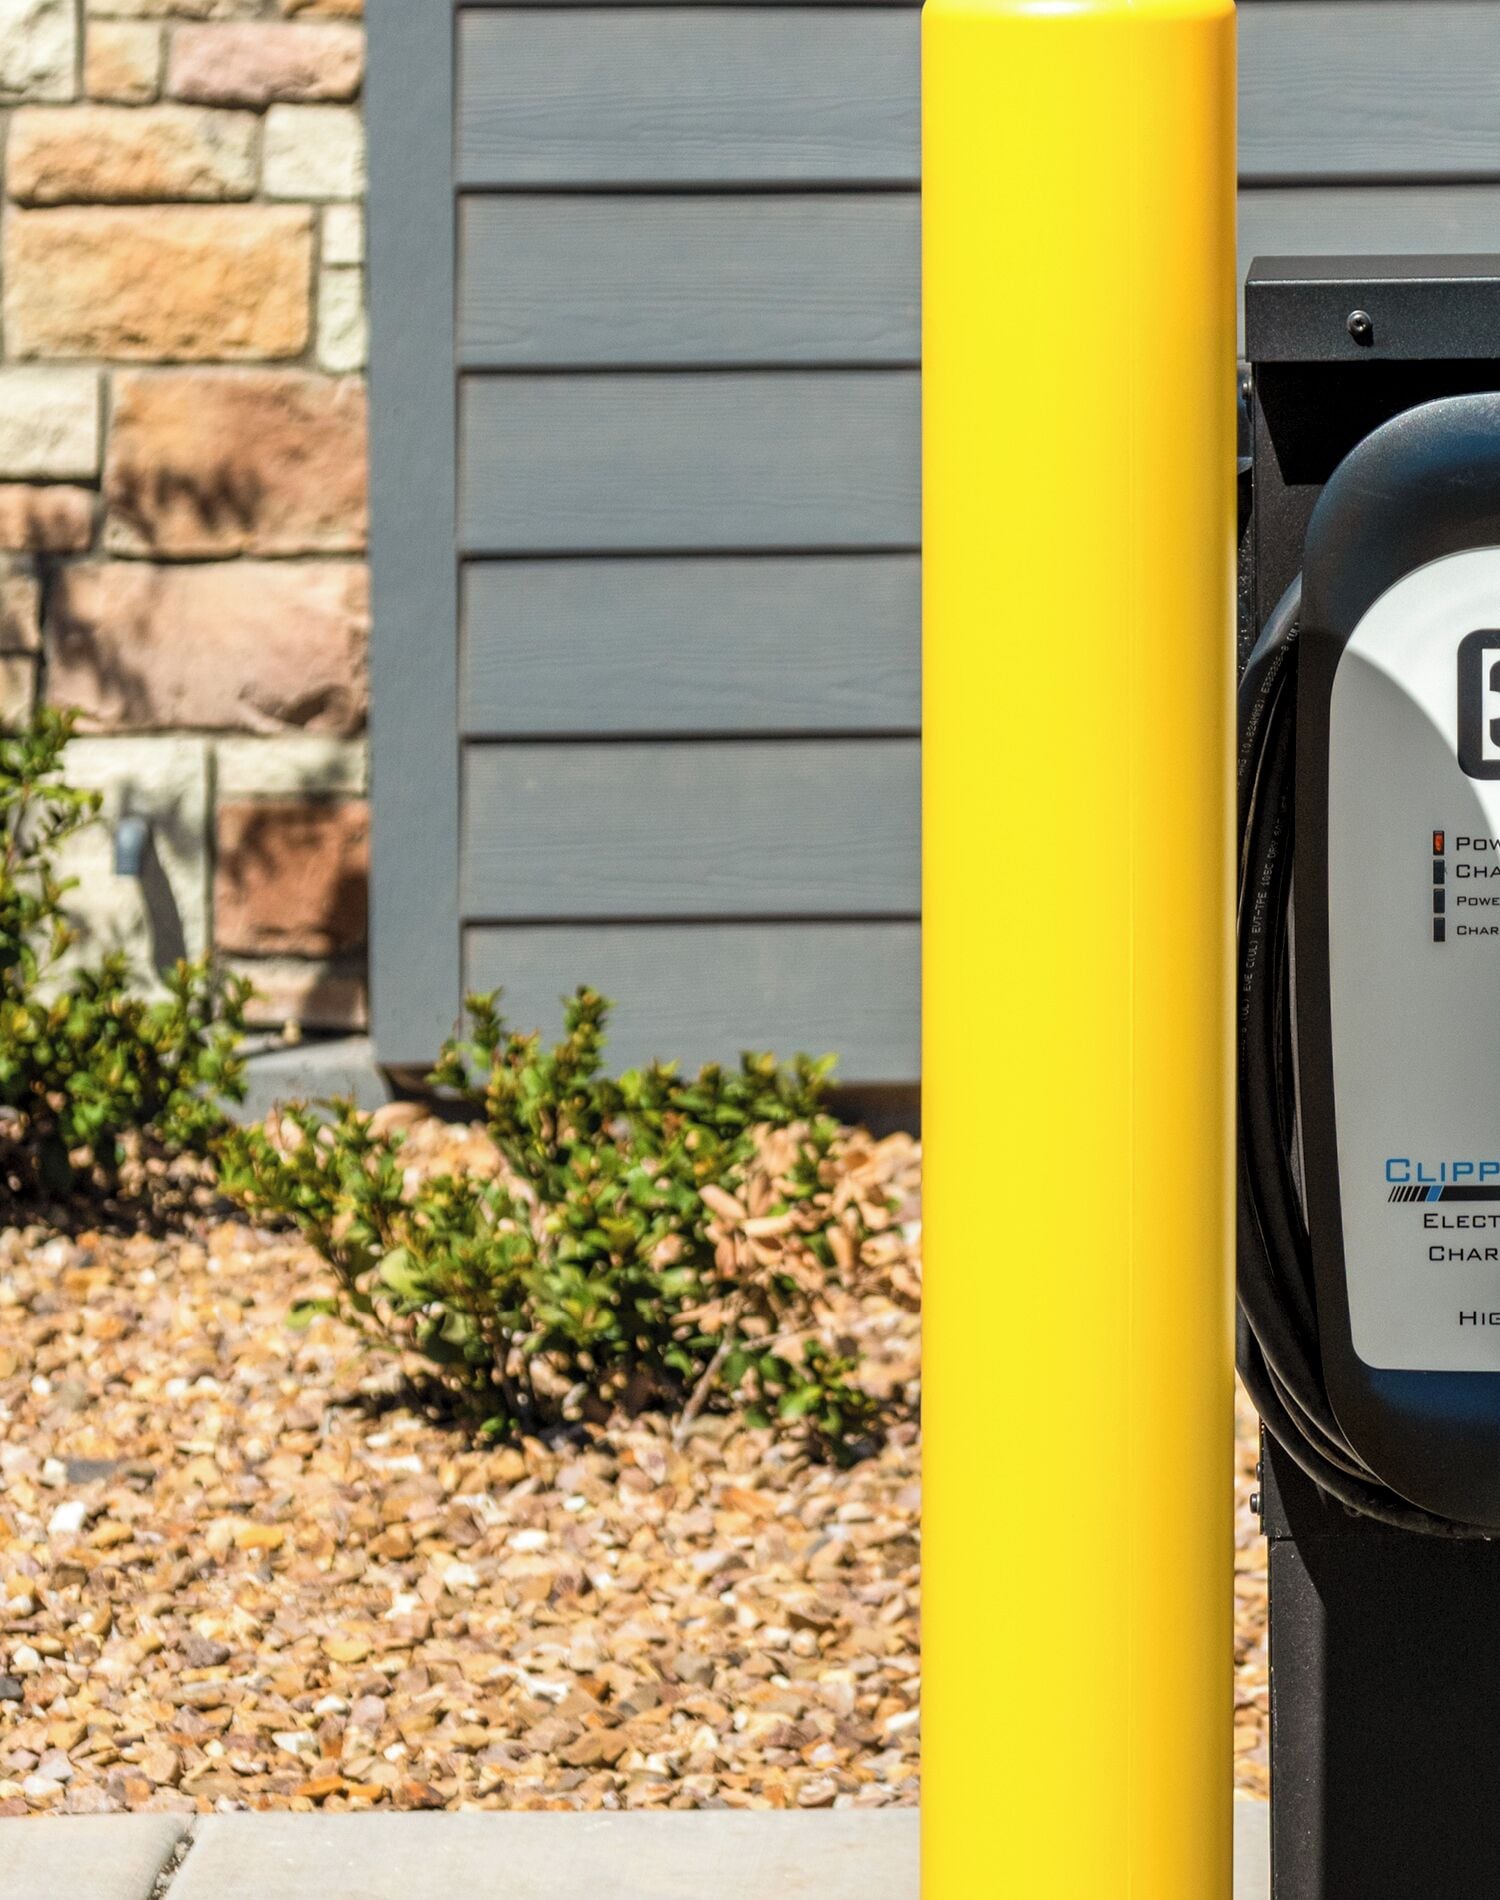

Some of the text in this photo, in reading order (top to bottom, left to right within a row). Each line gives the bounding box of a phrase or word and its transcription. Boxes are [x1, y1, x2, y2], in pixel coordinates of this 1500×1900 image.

[1260, 862, 1275, 887] 105C
[1251, 891, 1268, 934] EVT-TPE
[1245, 940, 1259, 969] C(UL)
[1243, 973, 1253, 992] EVE
